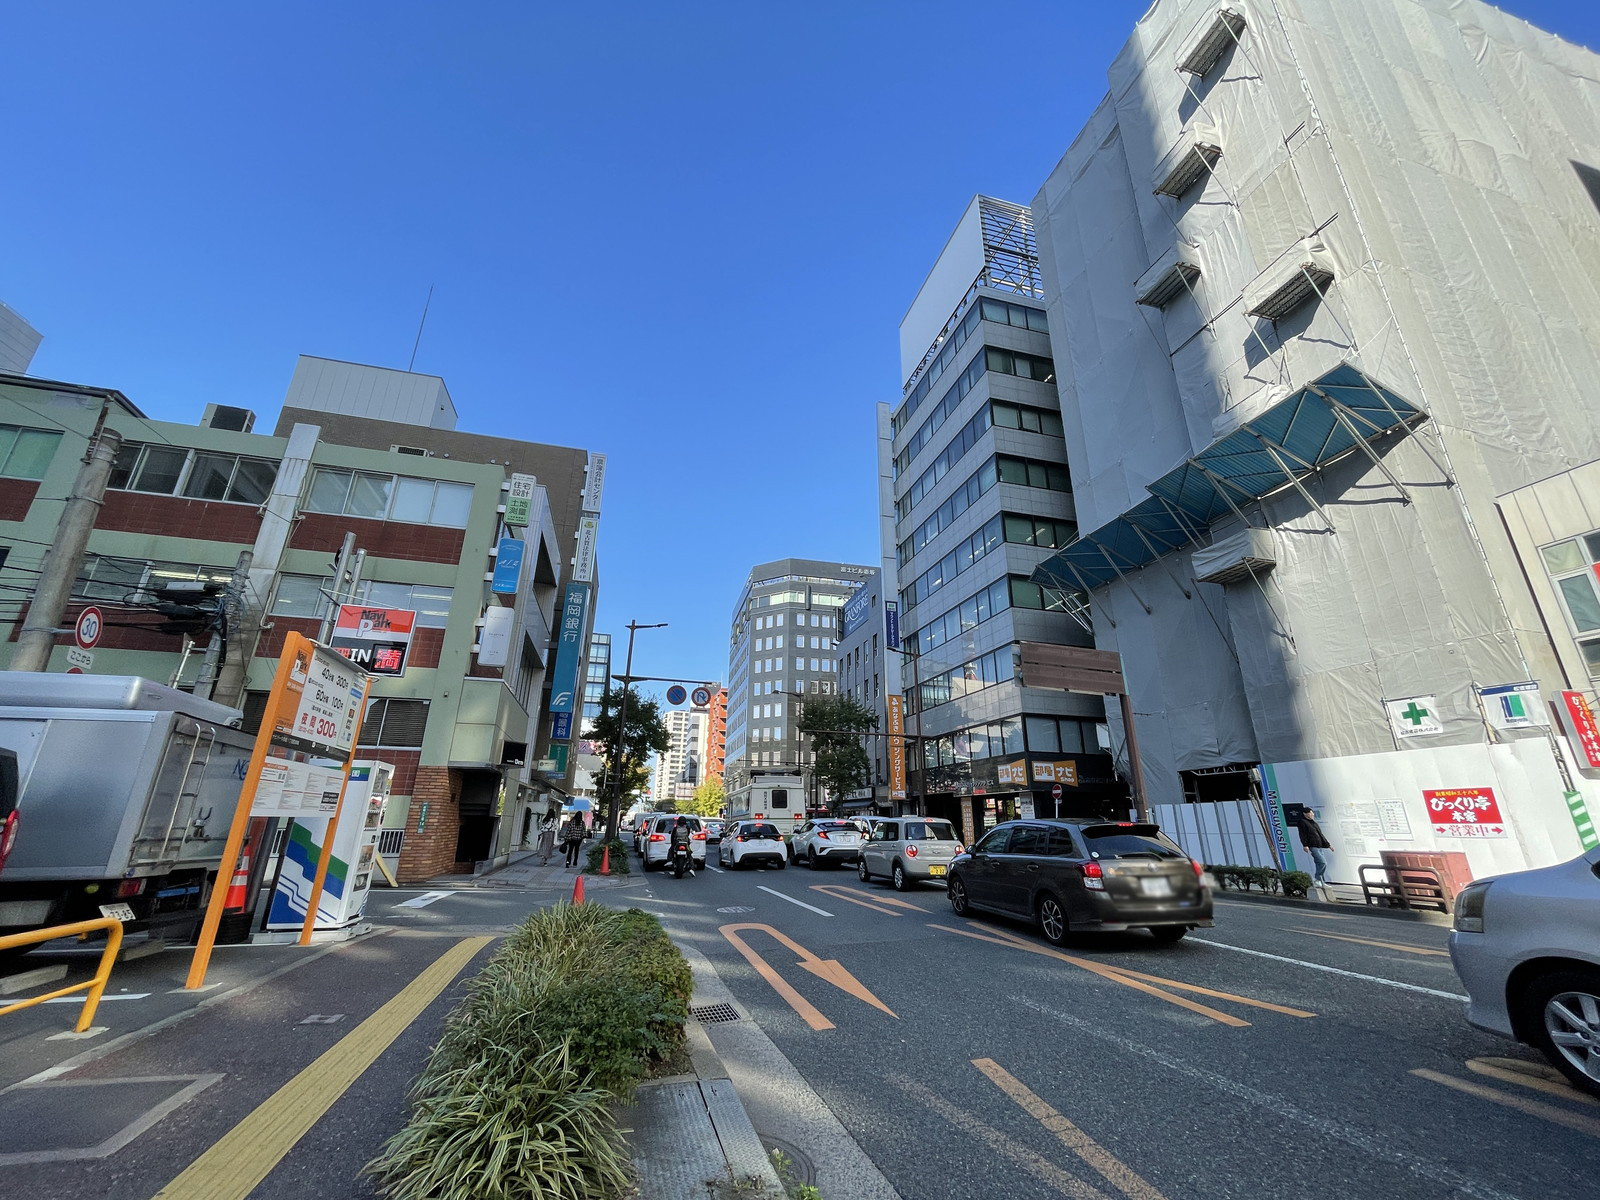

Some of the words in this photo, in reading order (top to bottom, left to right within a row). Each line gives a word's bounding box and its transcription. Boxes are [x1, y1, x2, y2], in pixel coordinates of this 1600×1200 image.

[513, 481, 531, 490] 住宅
[512, 489, 530, 498] 設計
[509, 507, 527, 516] 測量
[511, 500, 528, 508] 土地
[360, 609, 387, 621] Navi
[564, 592, 583, 643] 福岡銀行
[82, 617, 97, 638] 30
[356, 618, 392, 637] Park
[70, 650, 92, 666] ここから
[349, 648, 372, 663] IN
[374, 649, 402, 670] 満
[336, 675, 349, 690] 300円
[331, 696, 344, 711] 100円
[301, 713, 317, 729] 夜間
[316, 719, 337, 739] 300円
[1430, 796, 1491, 811] びっくり亭
[1267, 790, 1291, 854] Matsuyoshi
[1451, 810, 1478, 823] 本家
[1448, 825, 1489, 836] 営業中
